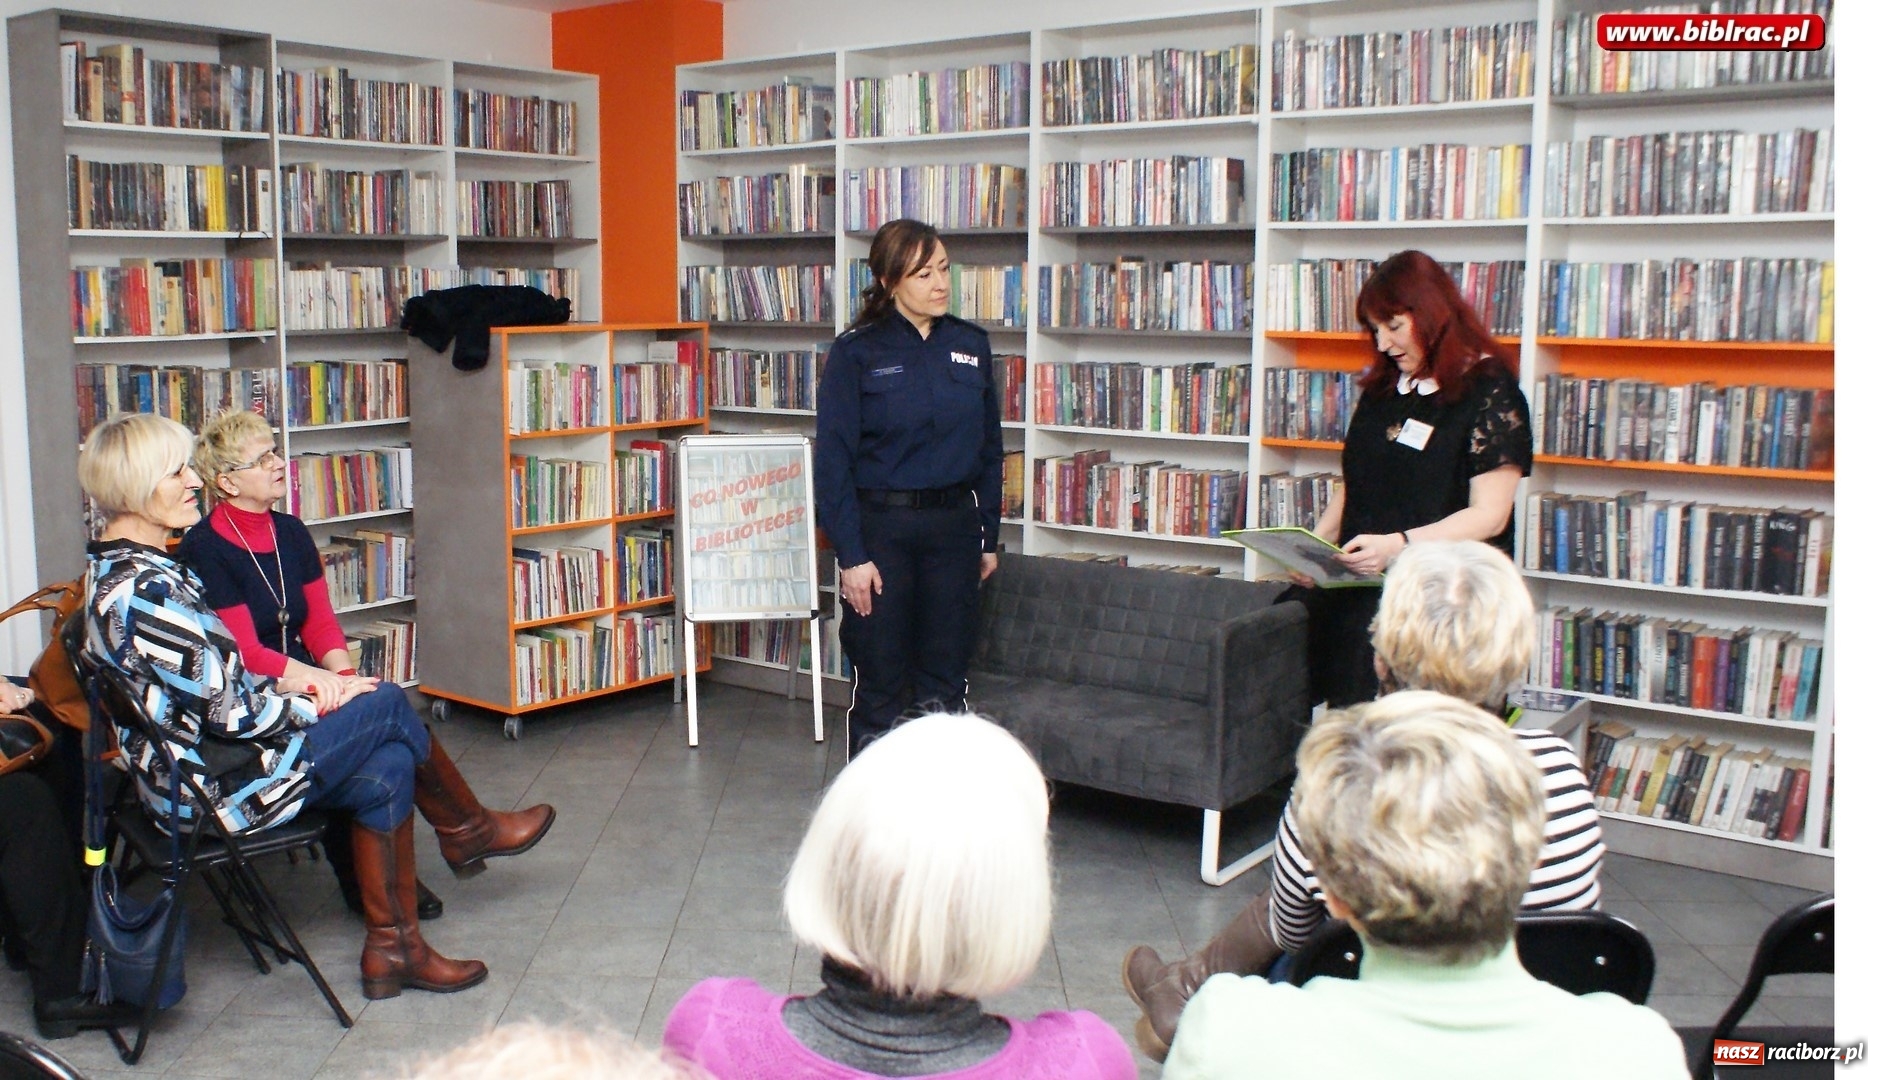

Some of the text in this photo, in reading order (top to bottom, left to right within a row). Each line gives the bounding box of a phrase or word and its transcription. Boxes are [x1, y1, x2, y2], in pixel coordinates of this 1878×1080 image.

[951, 351, 978, 368] POLICJA
[689, 460, 803, 510] CO NOWEGO
[740, 497, 760, 516] W
[694, 505, 805, 554] BIBLIOTECE?
